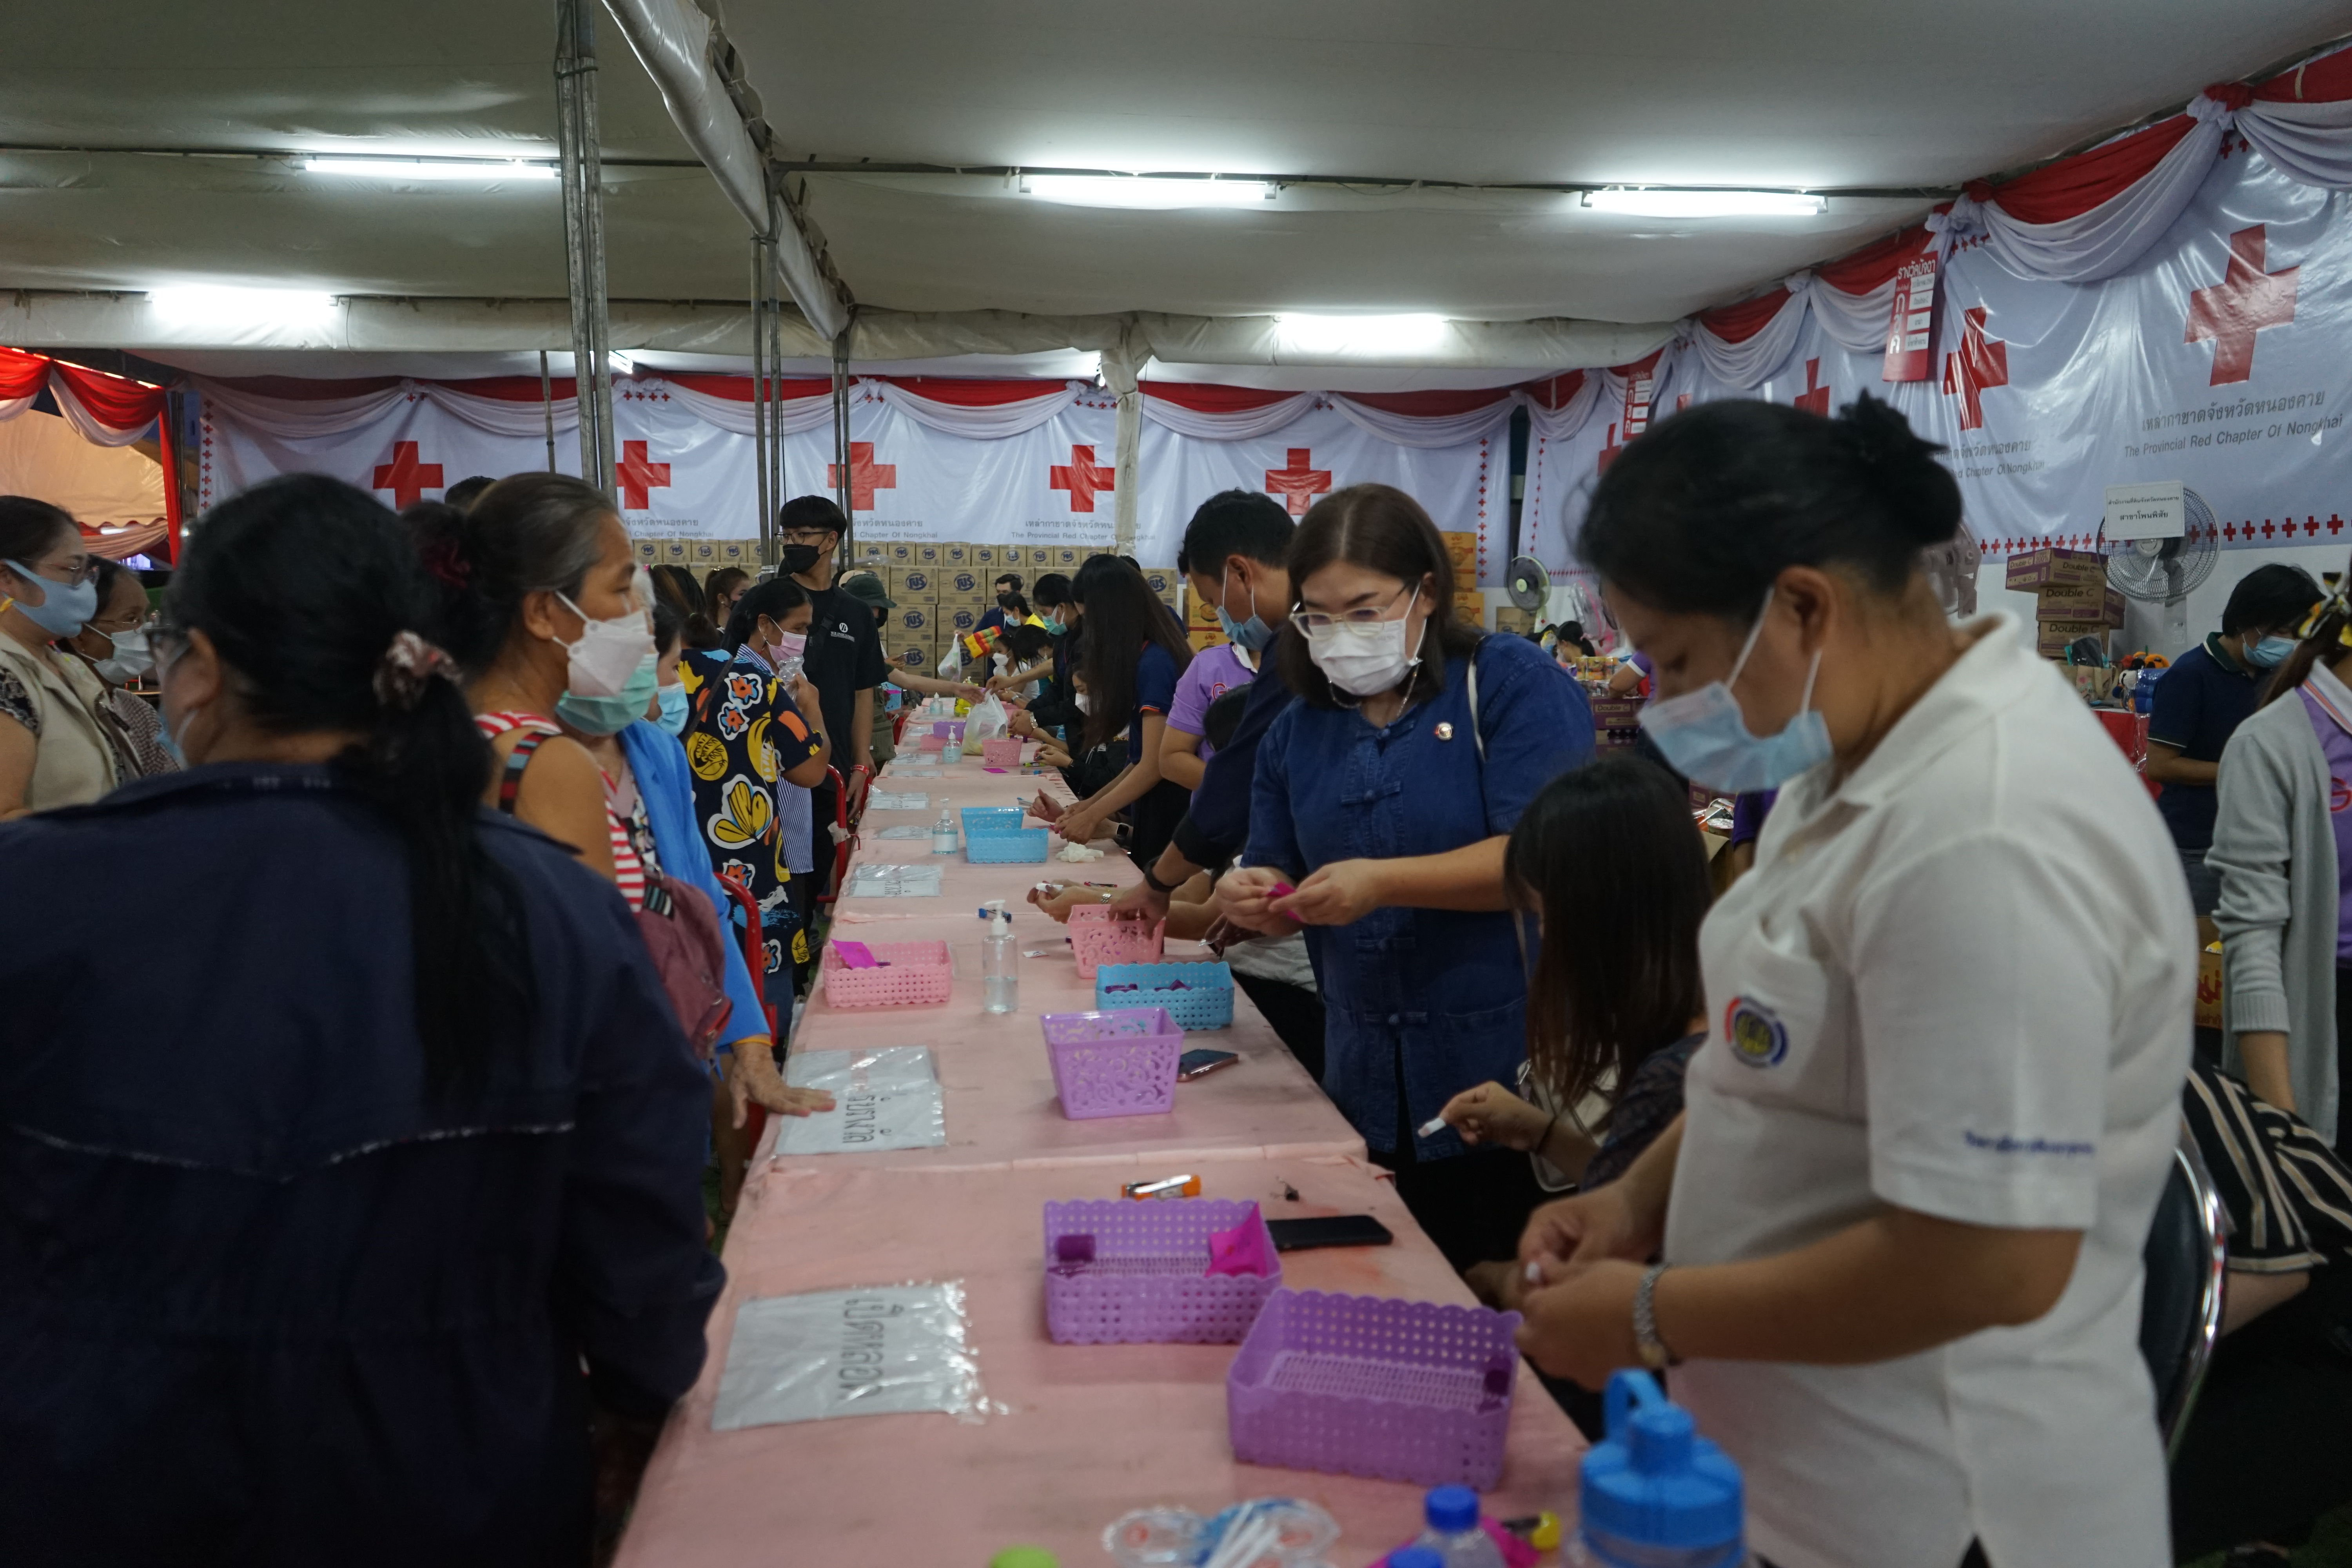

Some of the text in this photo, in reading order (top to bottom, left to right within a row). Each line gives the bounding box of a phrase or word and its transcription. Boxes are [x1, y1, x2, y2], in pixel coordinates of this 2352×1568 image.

[2142, 391, 2325, 431] เหล่ากาชาดจังหวัดหนองคาย
[2125, 414, 2343, 457] The Provincial Red Chapter Of Nongkhai
[625, 517, 699, 526] จังหวัดหนองคาย
[2063, 562, 2088, 572] Double
[2046, 588, 2094, 597] Double C
[2049, 623, 2088, 632] Double
